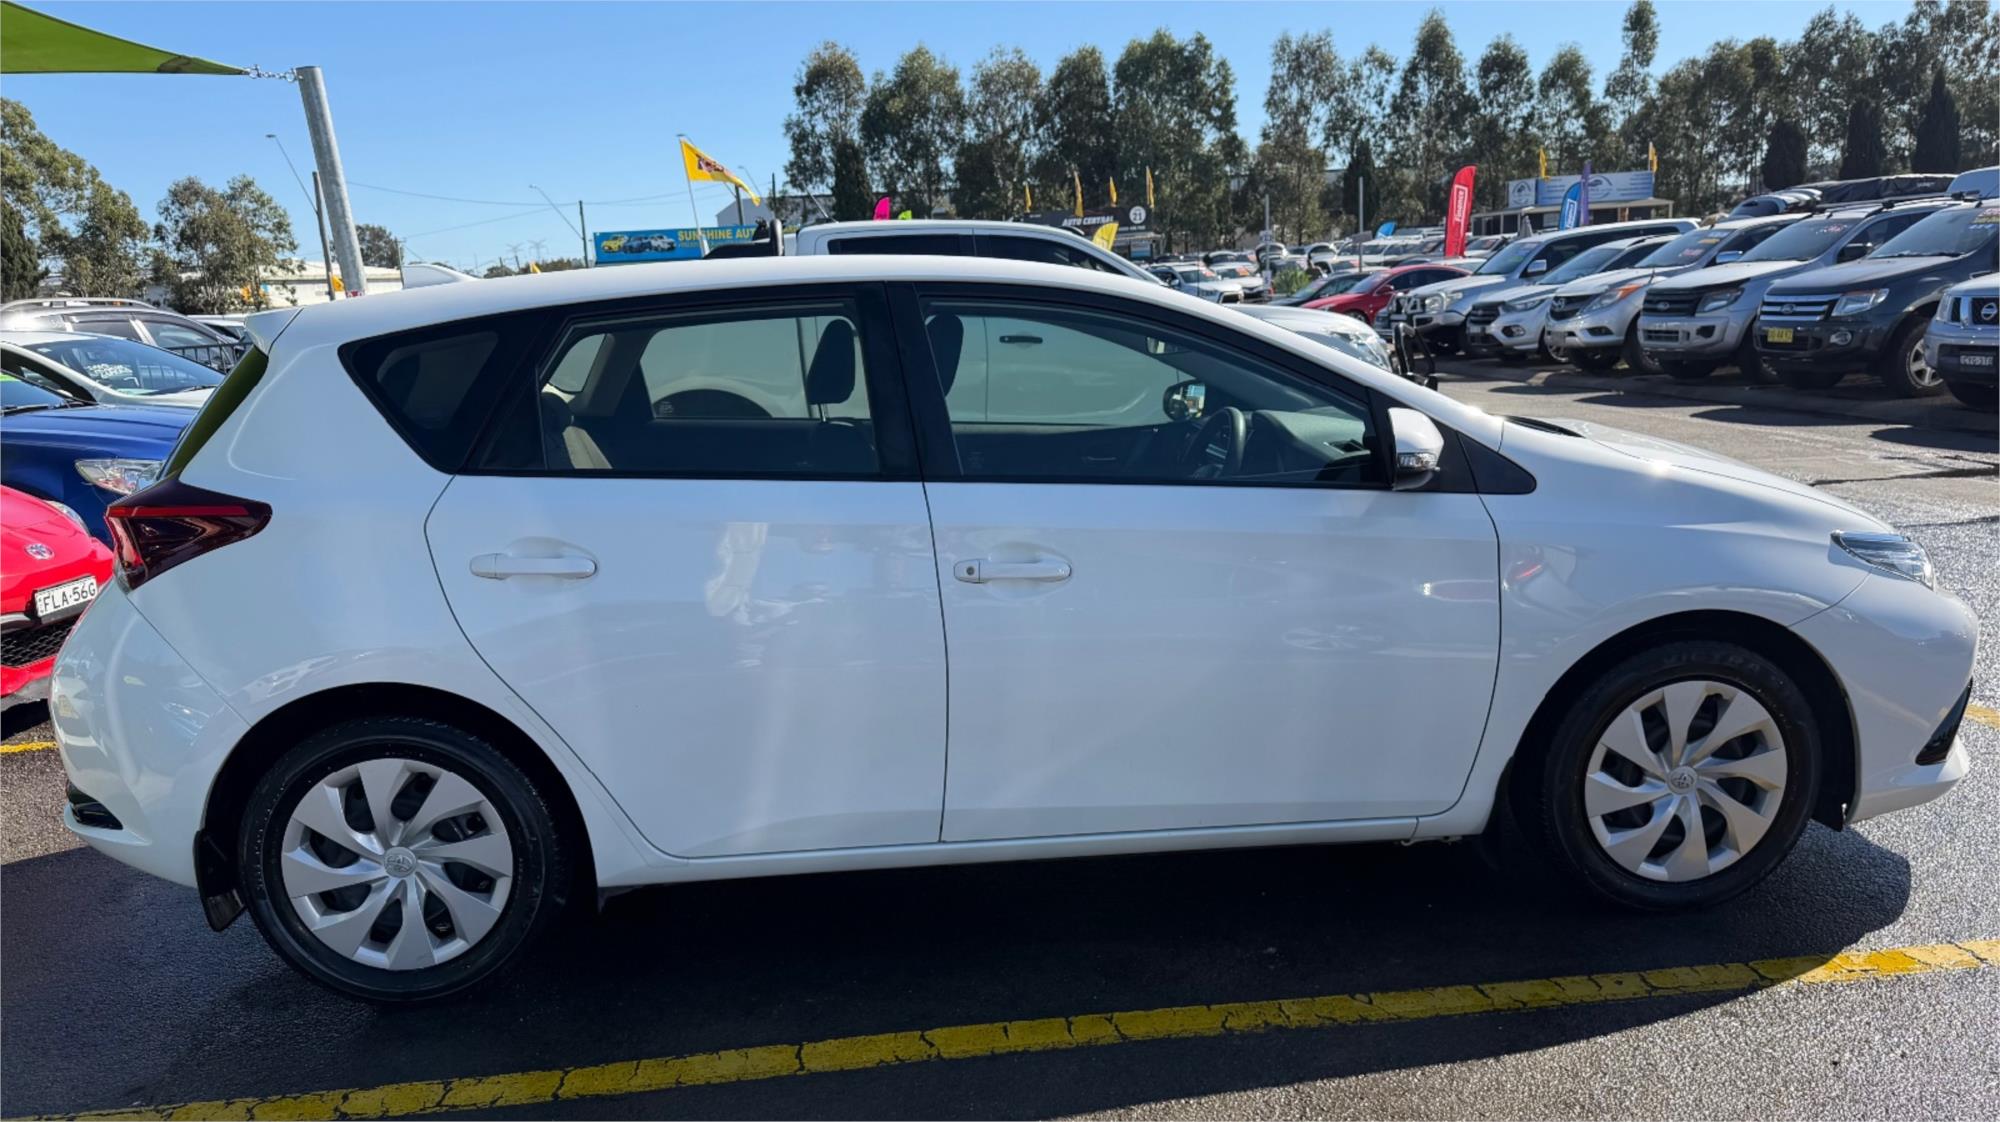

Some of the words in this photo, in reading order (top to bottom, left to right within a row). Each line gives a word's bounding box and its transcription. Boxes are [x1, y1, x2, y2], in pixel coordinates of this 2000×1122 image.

[1062, 218, 1081, 227] AUTO
[678, 229, 733, 241] SUNHINE
[736, 227, 757, 239] AUT
